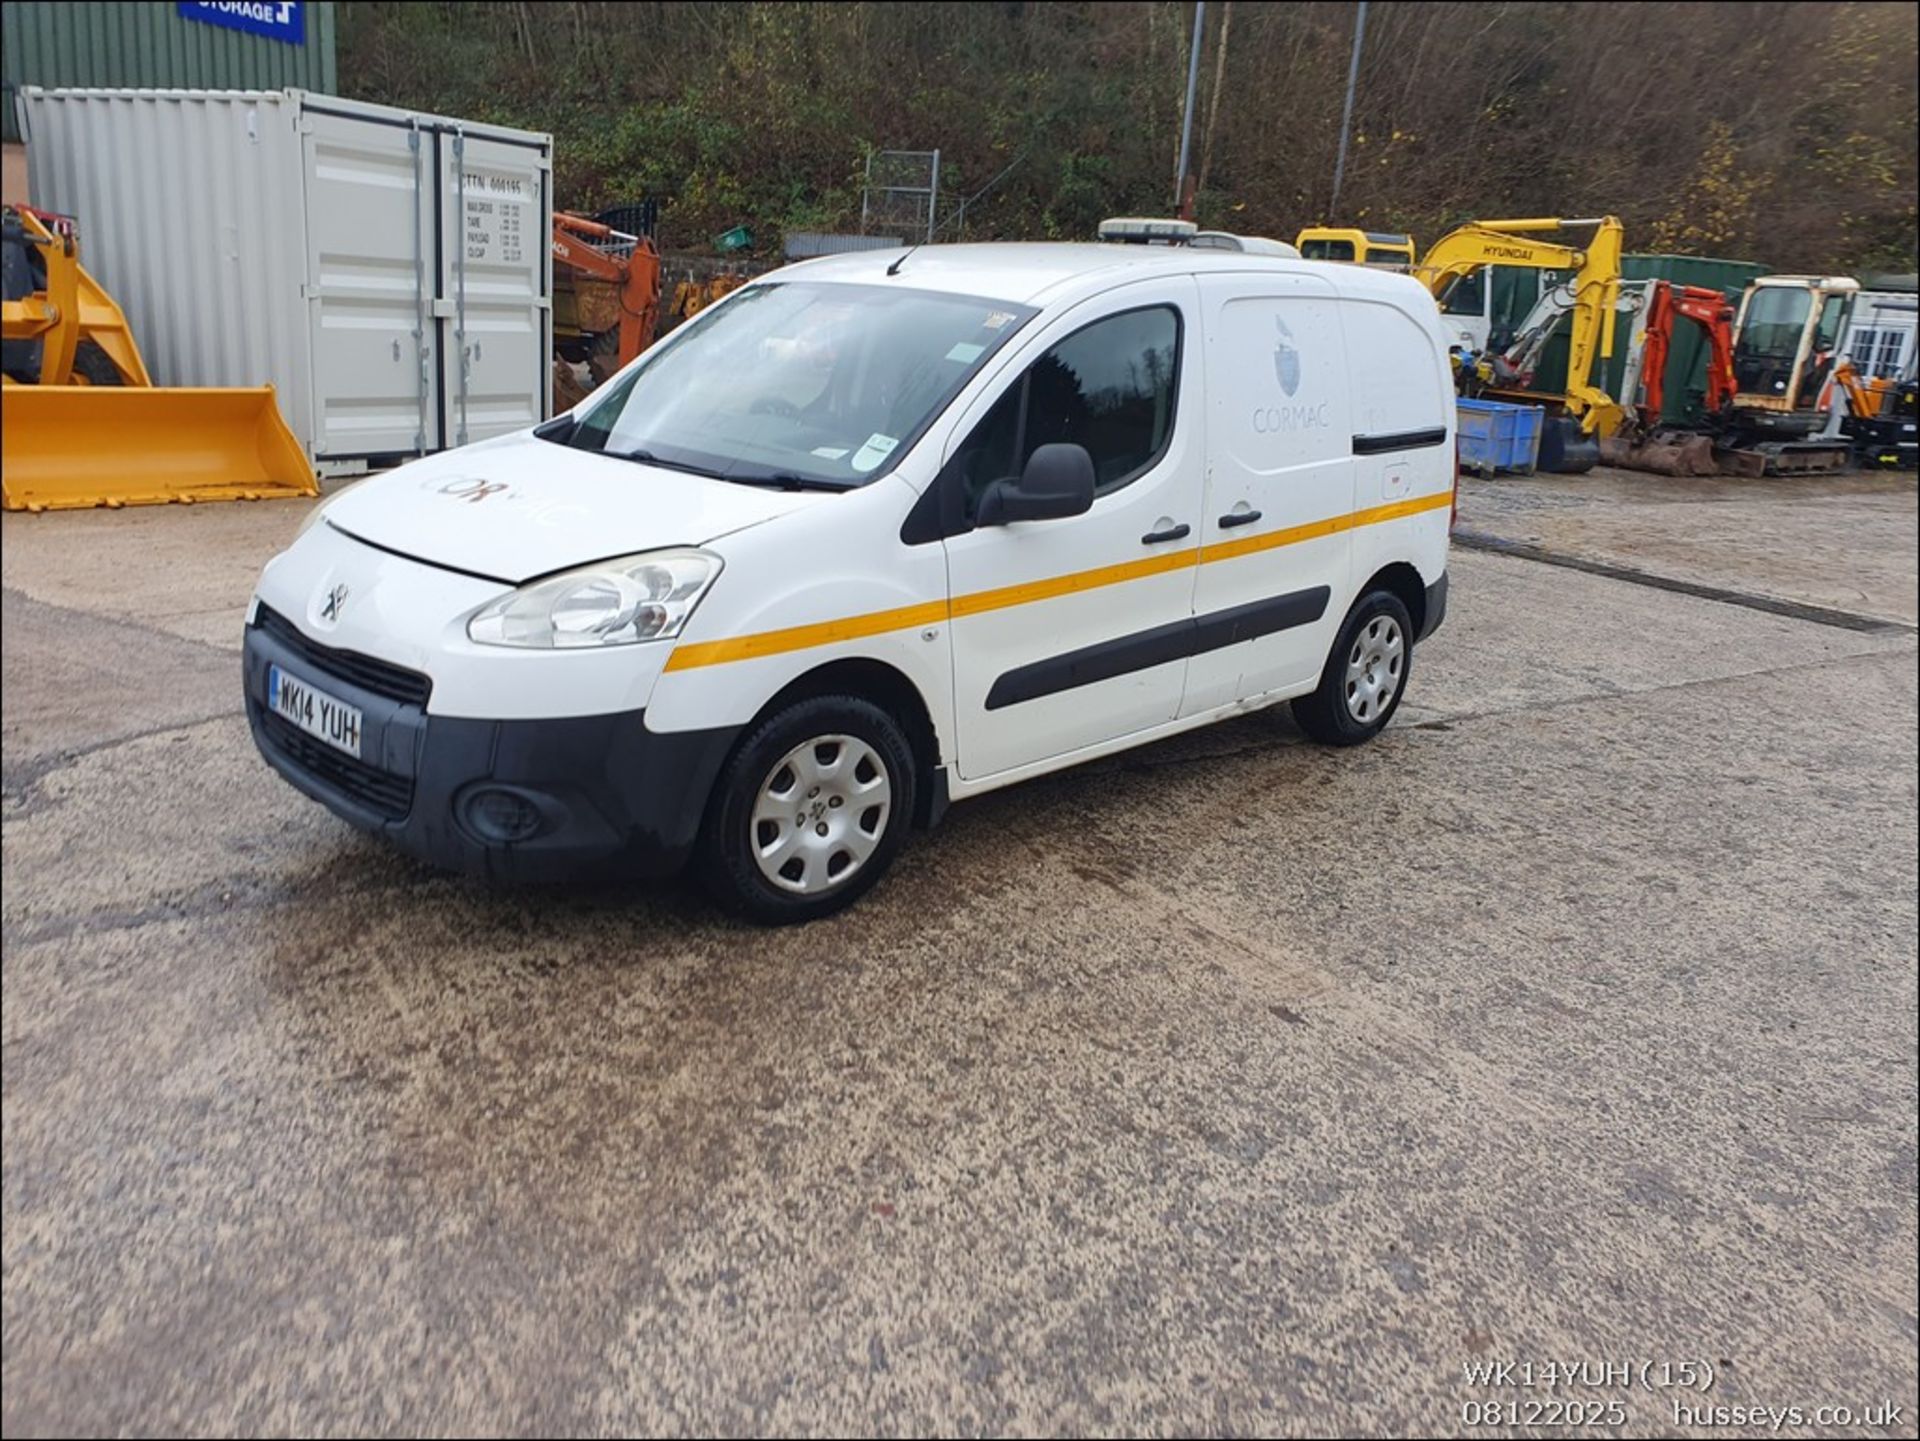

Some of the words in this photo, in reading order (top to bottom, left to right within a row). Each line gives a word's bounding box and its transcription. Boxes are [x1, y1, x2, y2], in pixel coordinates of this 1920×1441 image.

[1483, 245, 1533, 261] HYUNDAI
[1253, 403, 1329, 433] CORMAC
[281, 676, 314, 727] WK14
[320, 698, 356, 748] YUH
